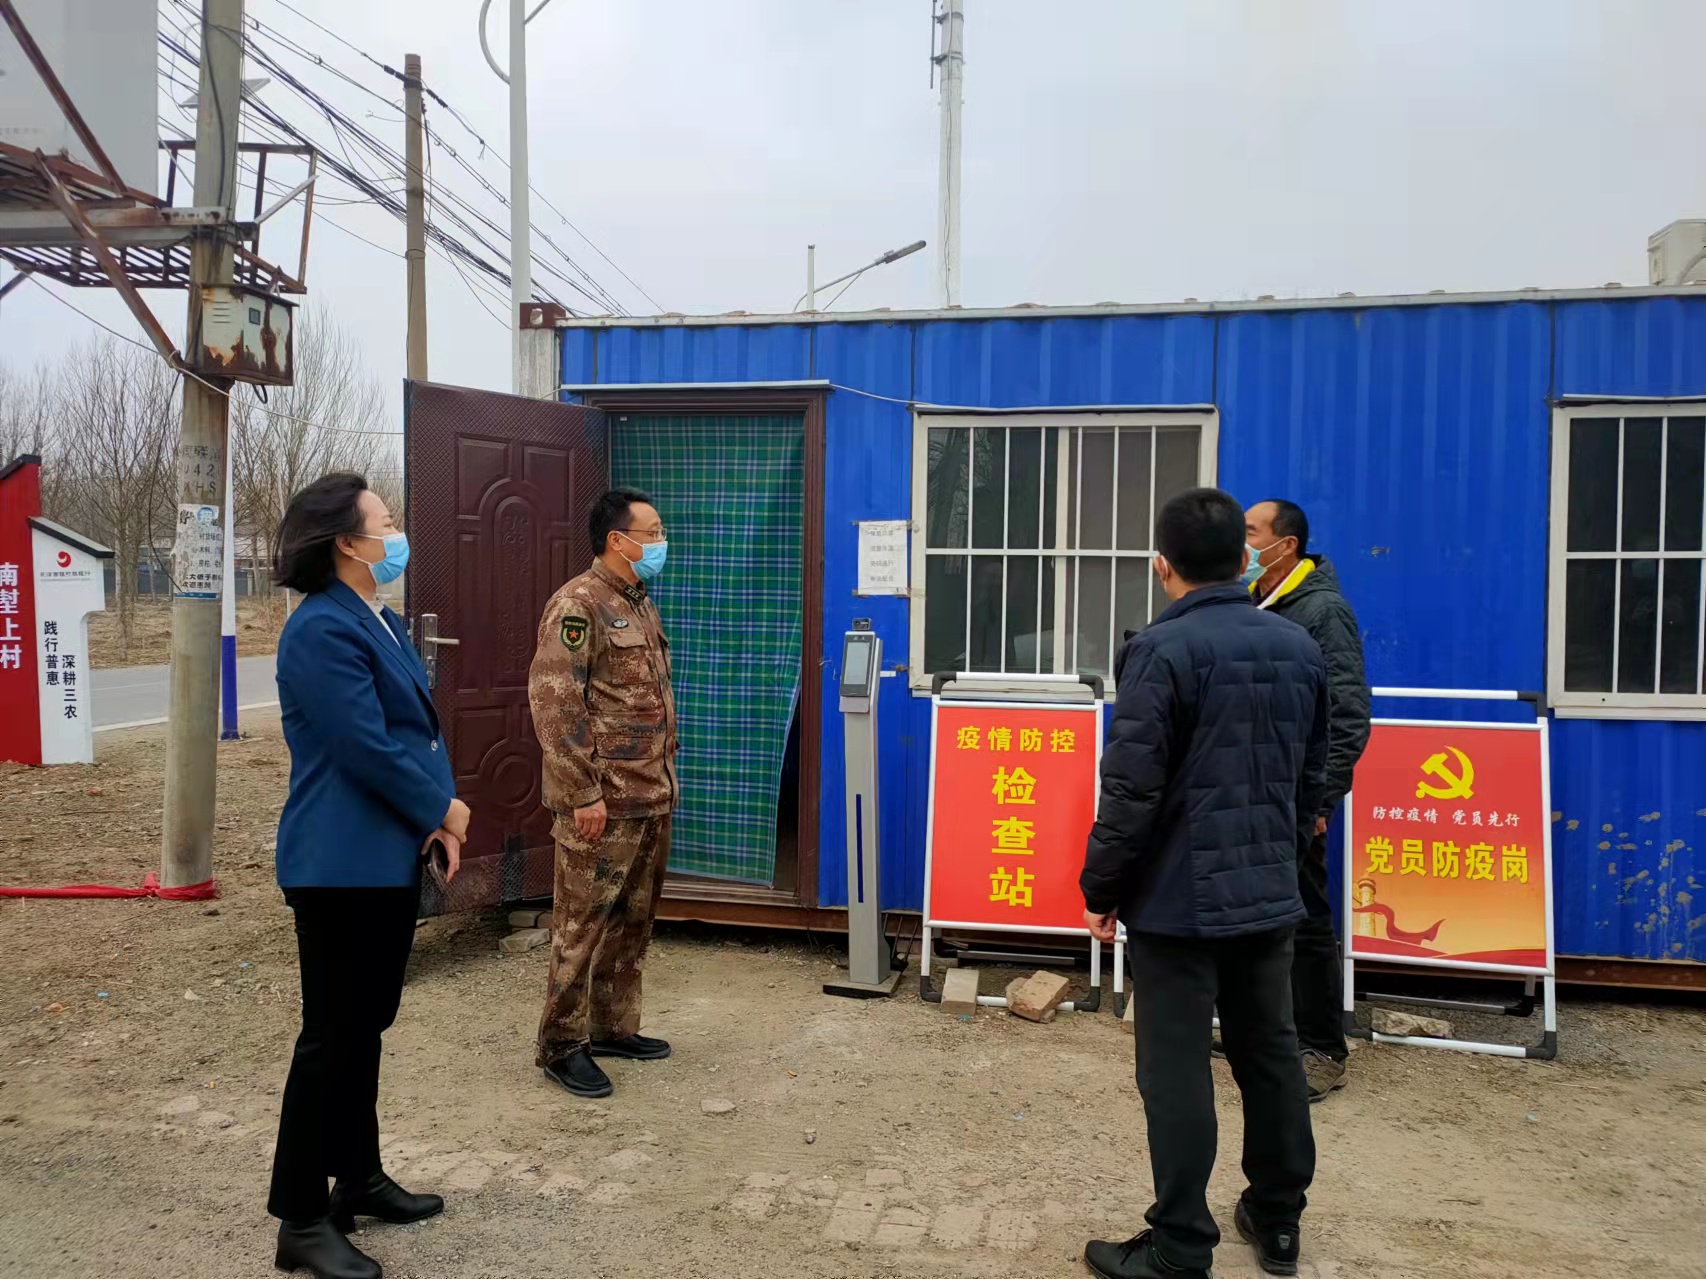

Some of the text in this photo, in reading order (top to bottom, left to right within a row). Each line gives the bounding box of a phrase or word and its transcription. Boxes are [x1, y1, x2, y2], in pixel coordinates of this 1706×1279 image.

[44, 621, 60, 686] 践行普惠
[62, 654, 78, 719] 深耕三农
[957, 725, 1076, 753] 疫情防控
[989, 766, 1037, 908] 检查站
[1372, 806, 1521, 827] 防控疫情 党员先行
[1365, 835, 1530, 884] 党员防疫岗
